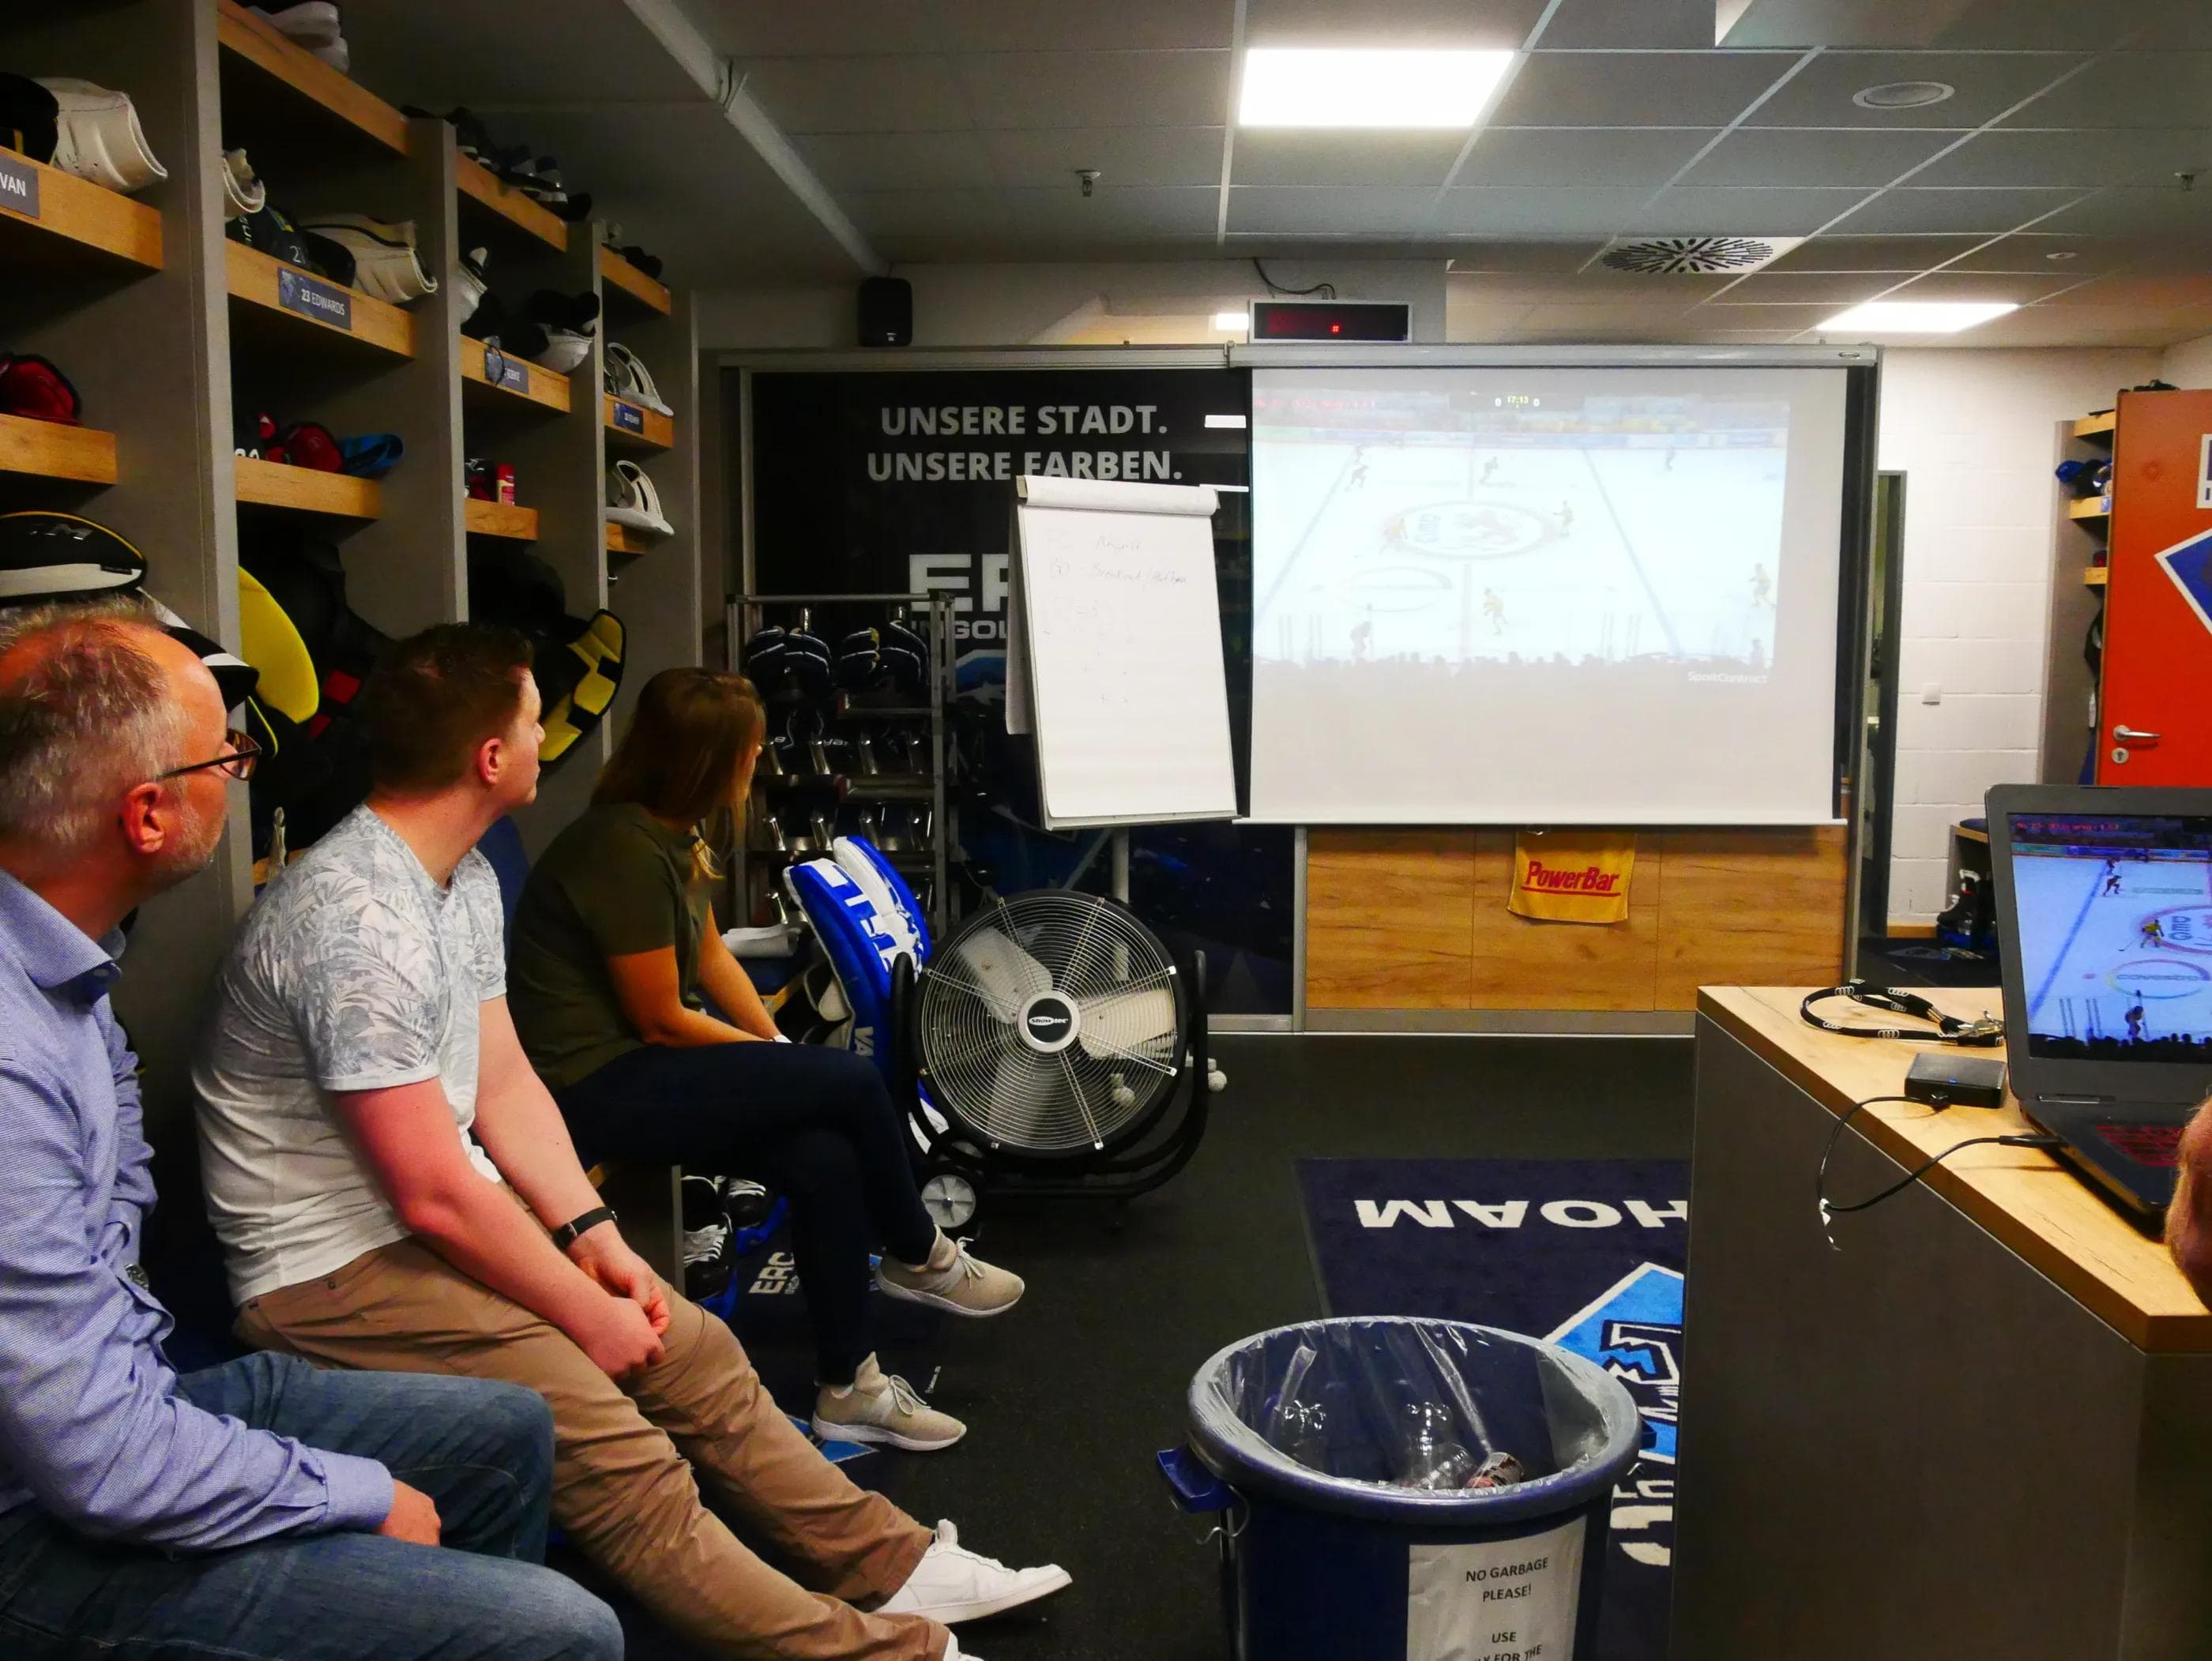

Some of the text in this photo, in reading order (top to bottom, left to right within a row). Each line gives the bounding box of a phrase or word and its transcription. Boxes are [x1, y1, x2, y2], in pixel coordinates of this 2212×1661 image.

[301, 288, 345, 316] 23 EDWARDS
[882, 405, 1168, 435] UNSERE STADT.
[868, 450, 1183, 481] UNSERE FARBEN.
[1525, 860, 1620, 891] PowerBar
[1466, 1557, 1549, 1582] NO GARBAGE
[1482, 1583, 1532, 1602] PLEASE!
[1492, 1632, 1517, 1644] USE
[1524, 1644, 1543, 1661] THE
